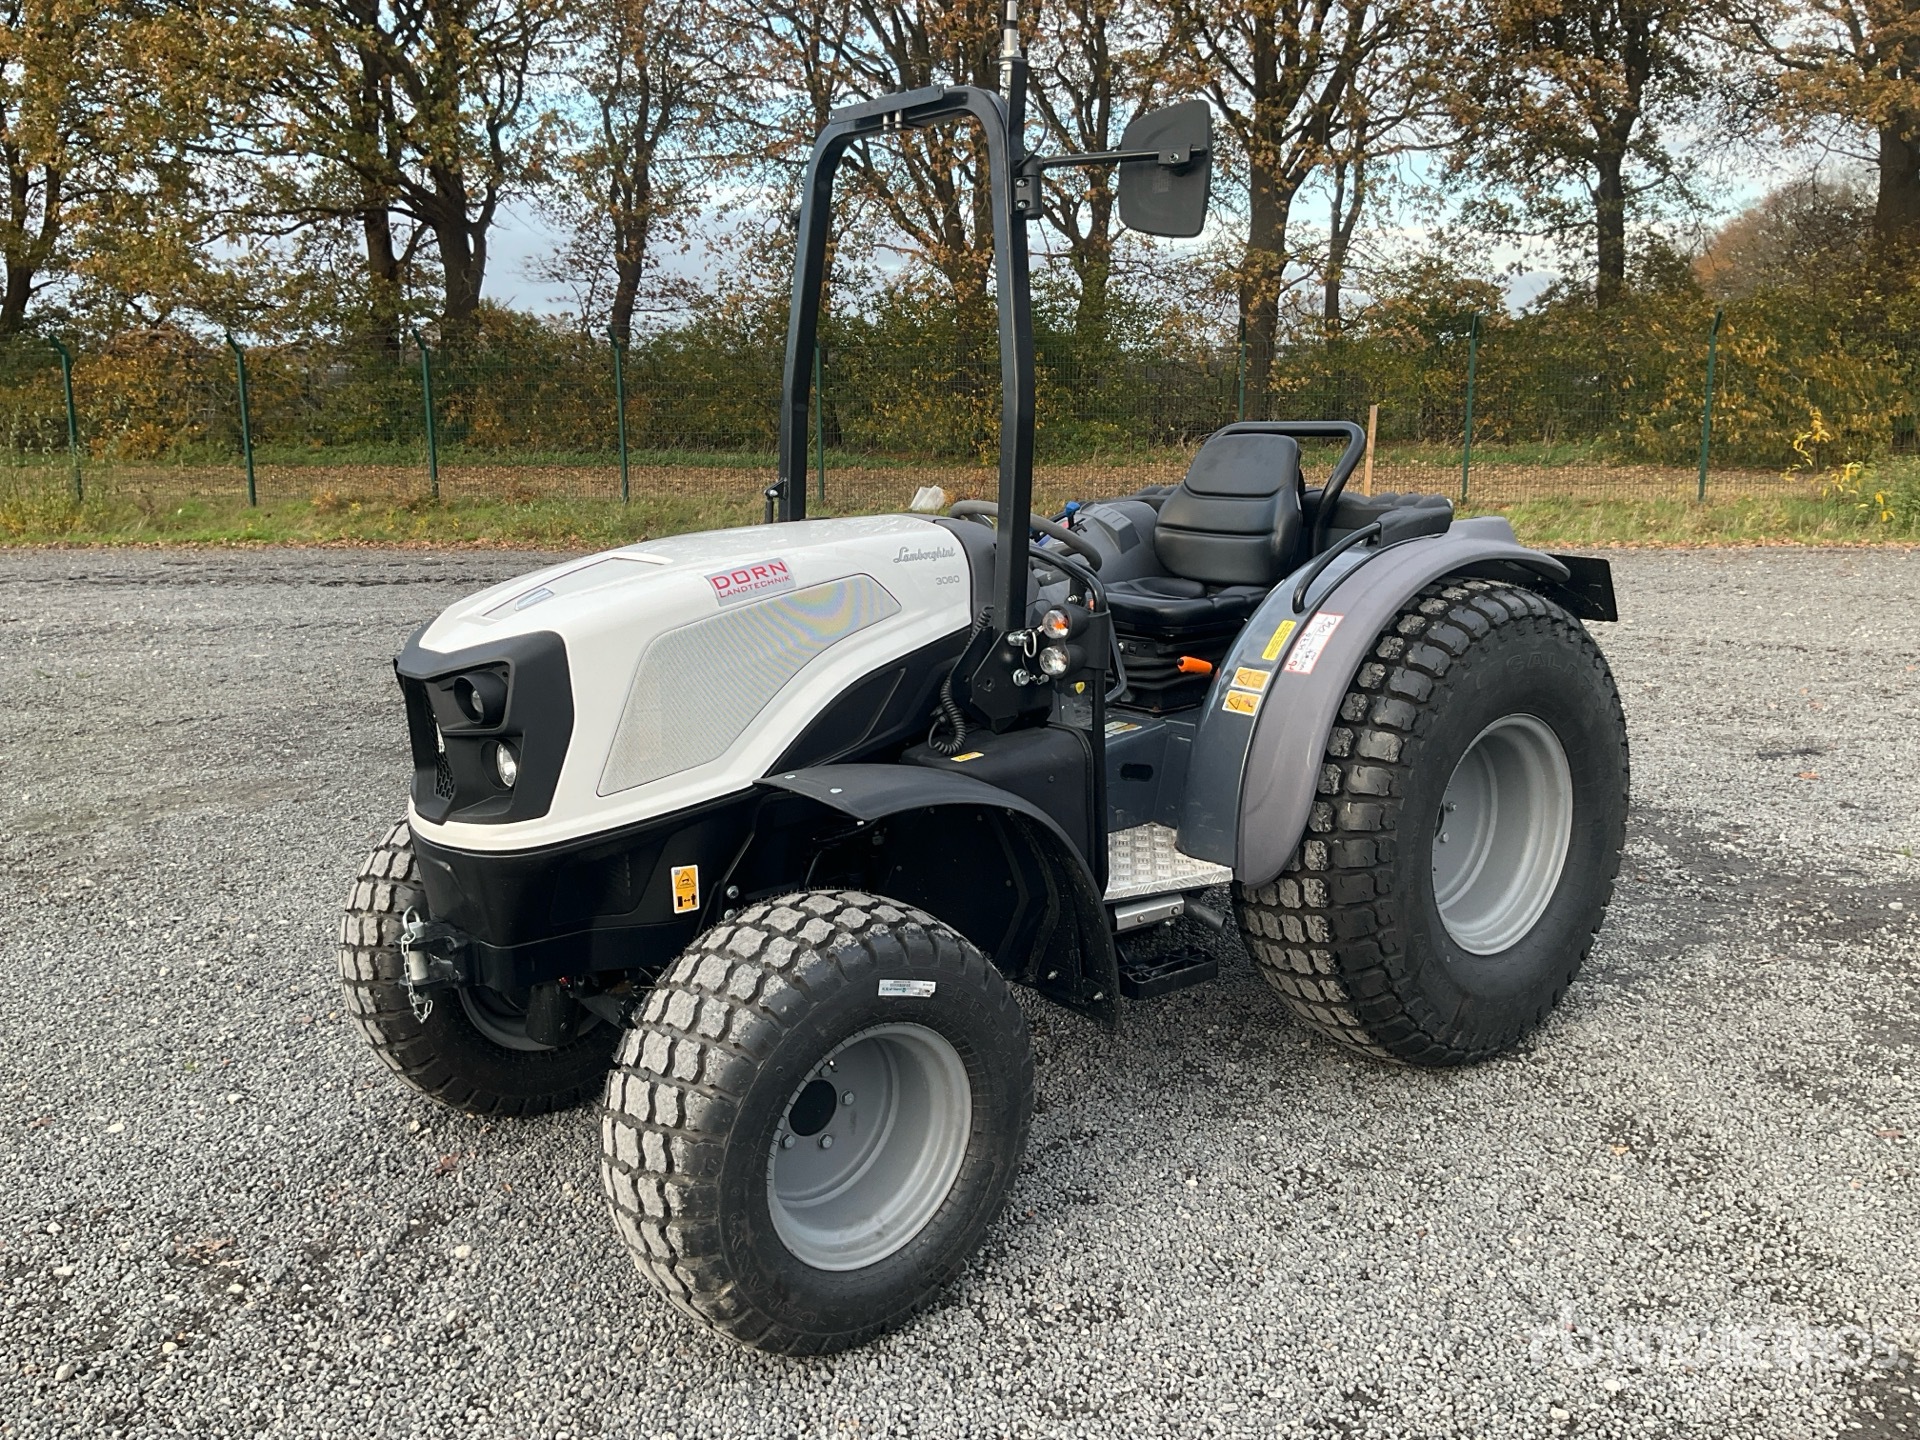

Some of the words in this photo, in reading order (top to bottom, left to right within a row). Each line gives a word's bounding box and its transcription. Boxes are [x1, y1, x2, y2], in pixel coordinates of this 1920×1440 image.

[893, 546, 956, 564] Lamborghini
[711, 561, 788, 591] DORN
[935, 575, 960, 586] 3060
[719, 575, 791, 598] LANDTECHNIK
